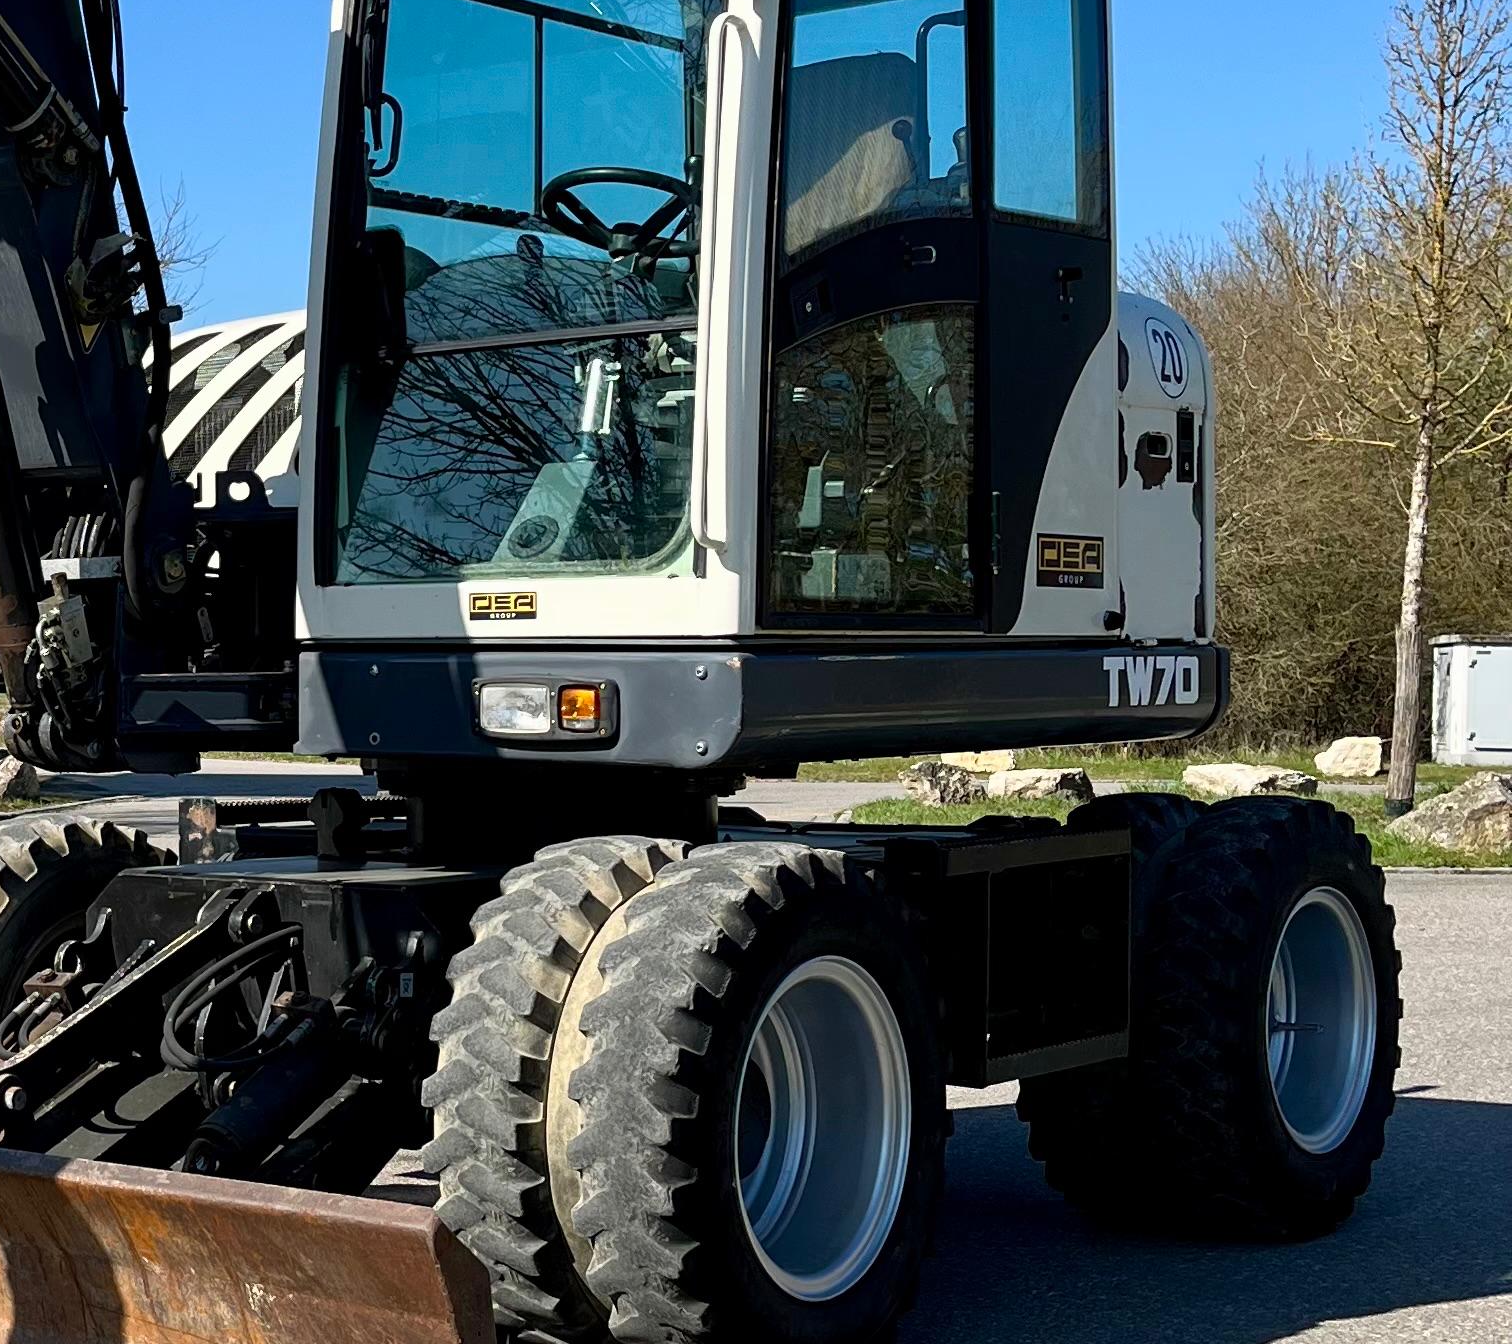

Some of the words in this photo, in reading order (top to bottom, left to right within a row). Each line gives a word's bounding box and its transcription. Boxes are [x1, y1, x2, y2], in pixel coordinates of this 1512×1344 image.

[1151, 328, 1183, 385] 20
[1058, 574, 1084, 585] GROUP
[1103, 655, 1200, 708] TW70
